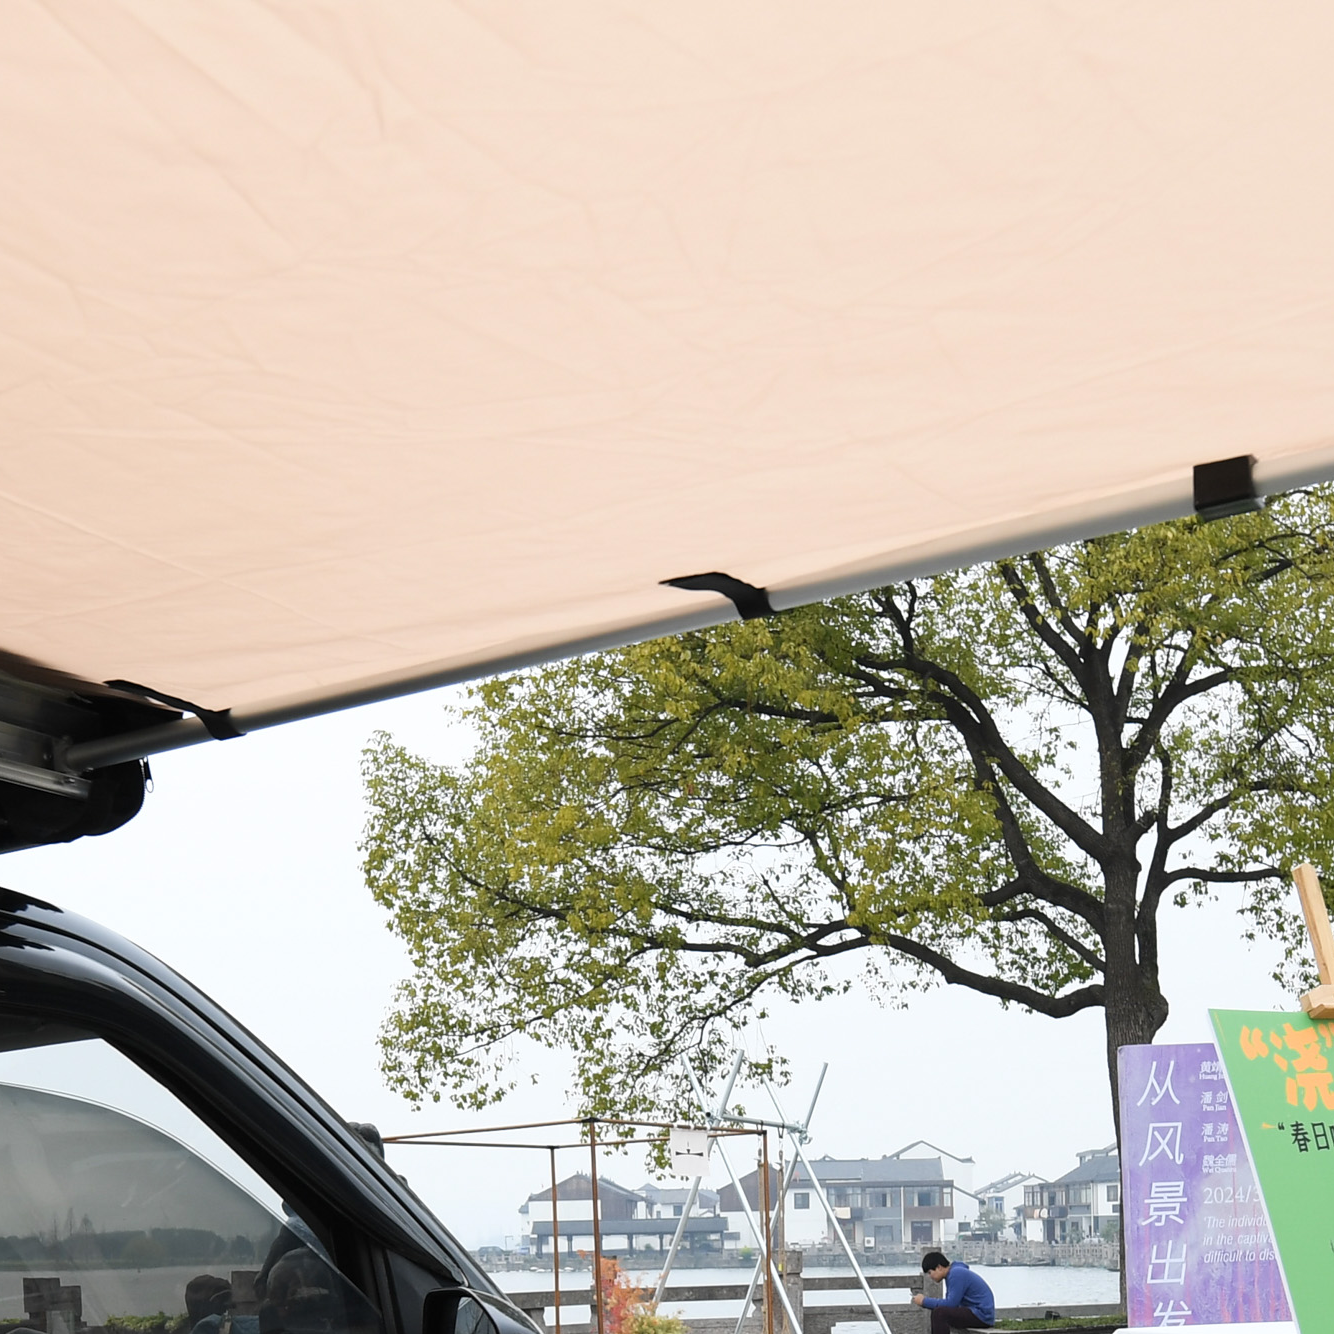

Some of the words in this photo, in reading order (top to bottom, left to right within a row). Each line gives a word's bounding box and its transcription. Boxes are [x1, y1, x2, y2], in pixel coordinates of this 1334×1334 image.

[1202, 1234, 1213, 1246] in
[1217, 1233, 1234, 1245] the
[1203, 1250, 1242, 1264] difficult
[1245, 1249, 1256, 1262] to
